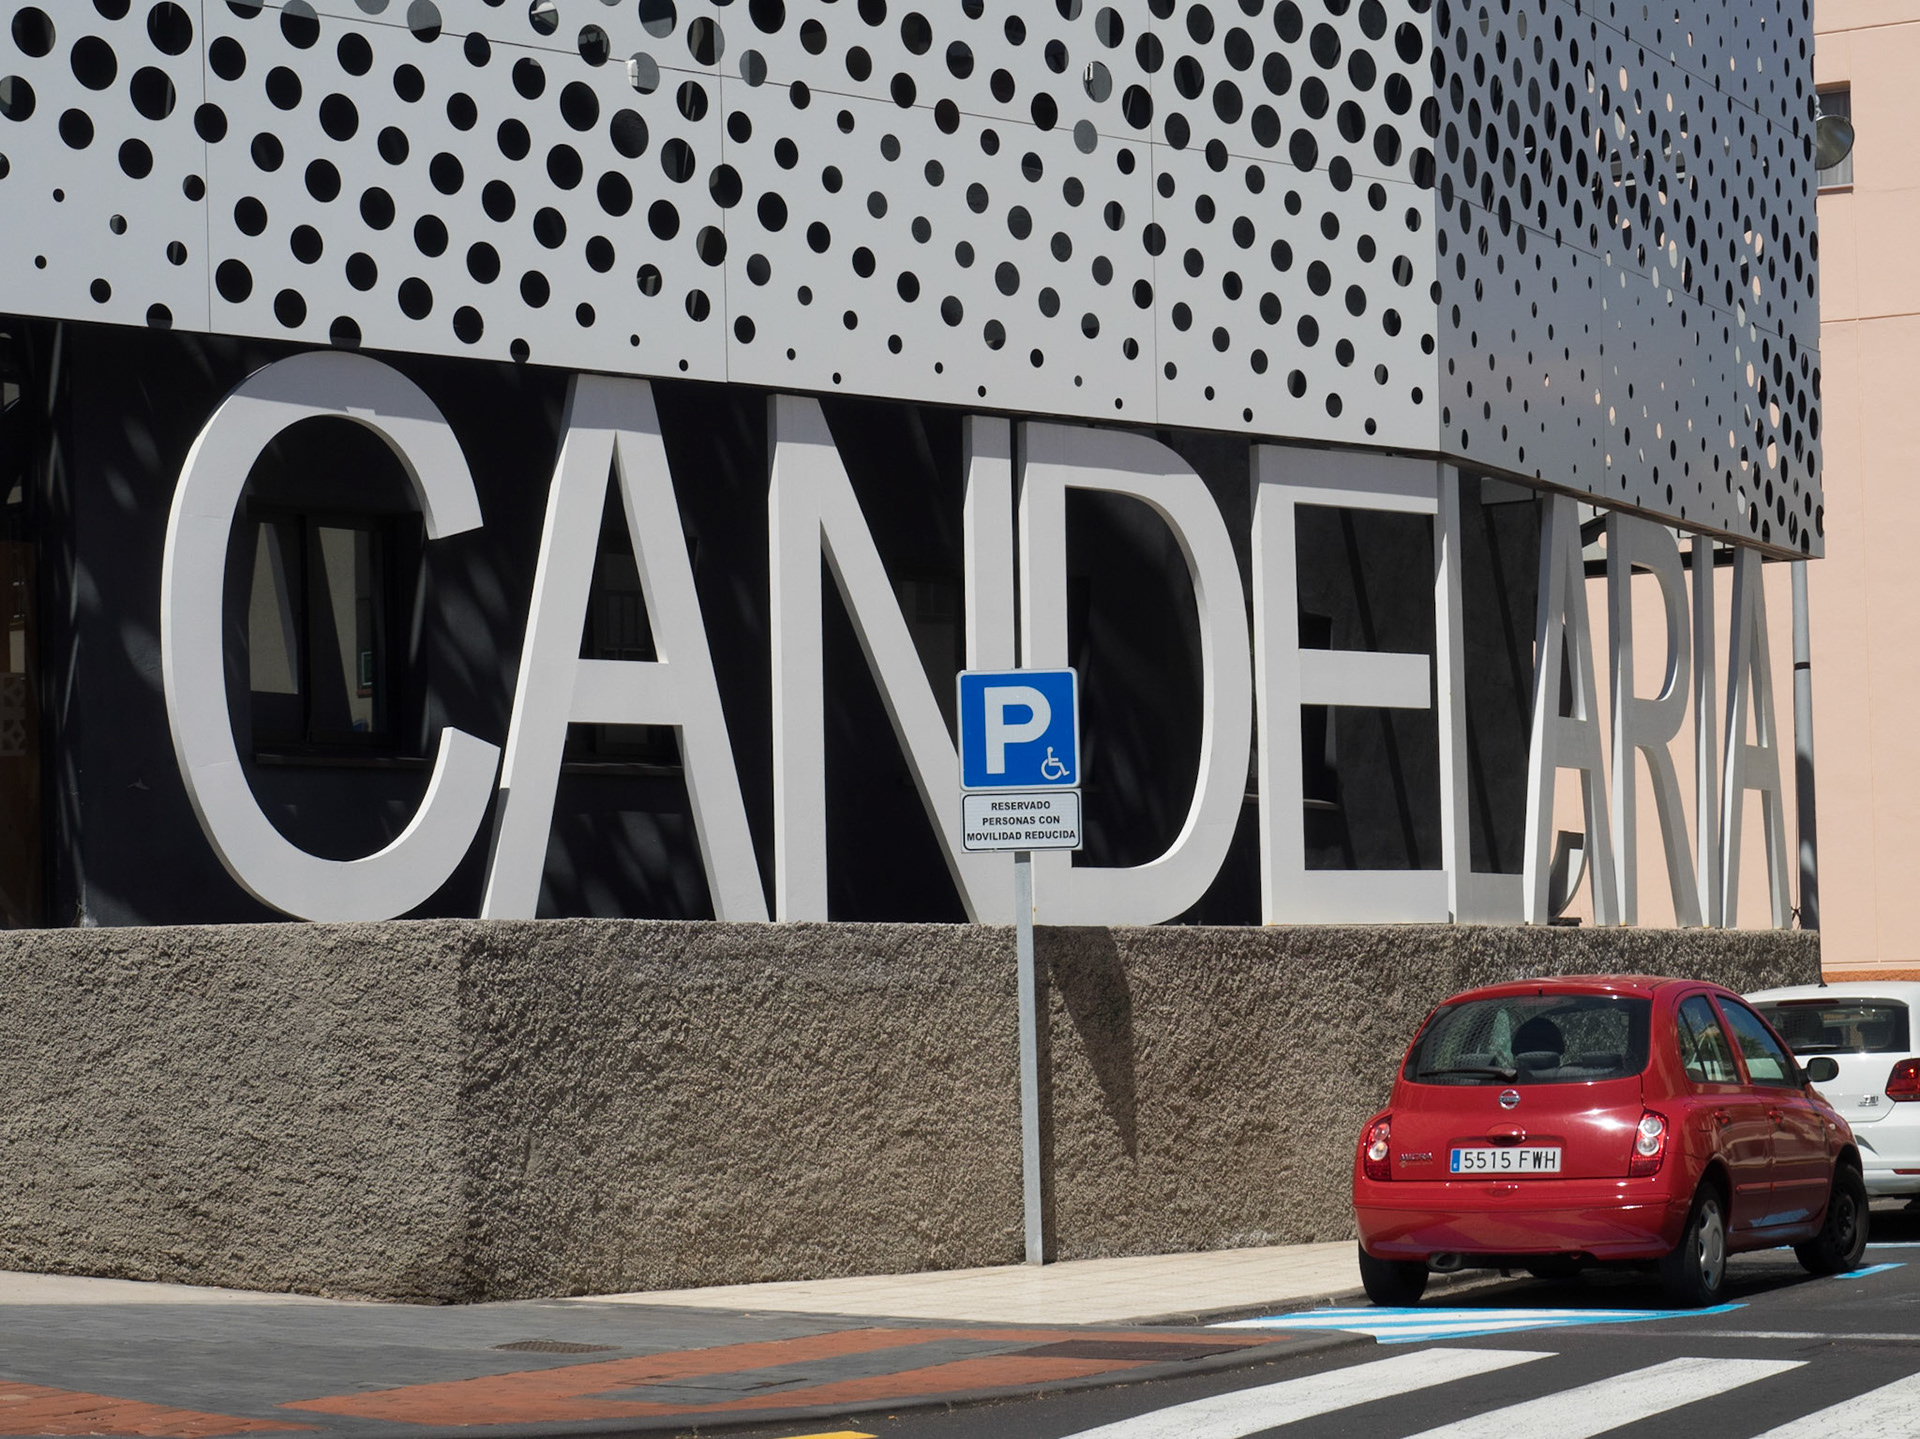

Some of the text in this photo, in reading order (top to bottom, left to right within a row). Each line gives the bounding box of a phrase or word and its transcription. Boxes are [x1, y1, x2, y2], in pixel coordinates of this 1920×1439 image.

[161, 351, 1793, 930] CANDELARIA
[984, 686, 1051, 774] P
[991, 801, 1051, 811] RESERVADO
[982, 815, 1060, 826] PERSONAS CON
[967, 830, 1076, 841] MOVILIDAD REDUCIDA
[1464, 1150, 1556, 1169] 5515 FWH
